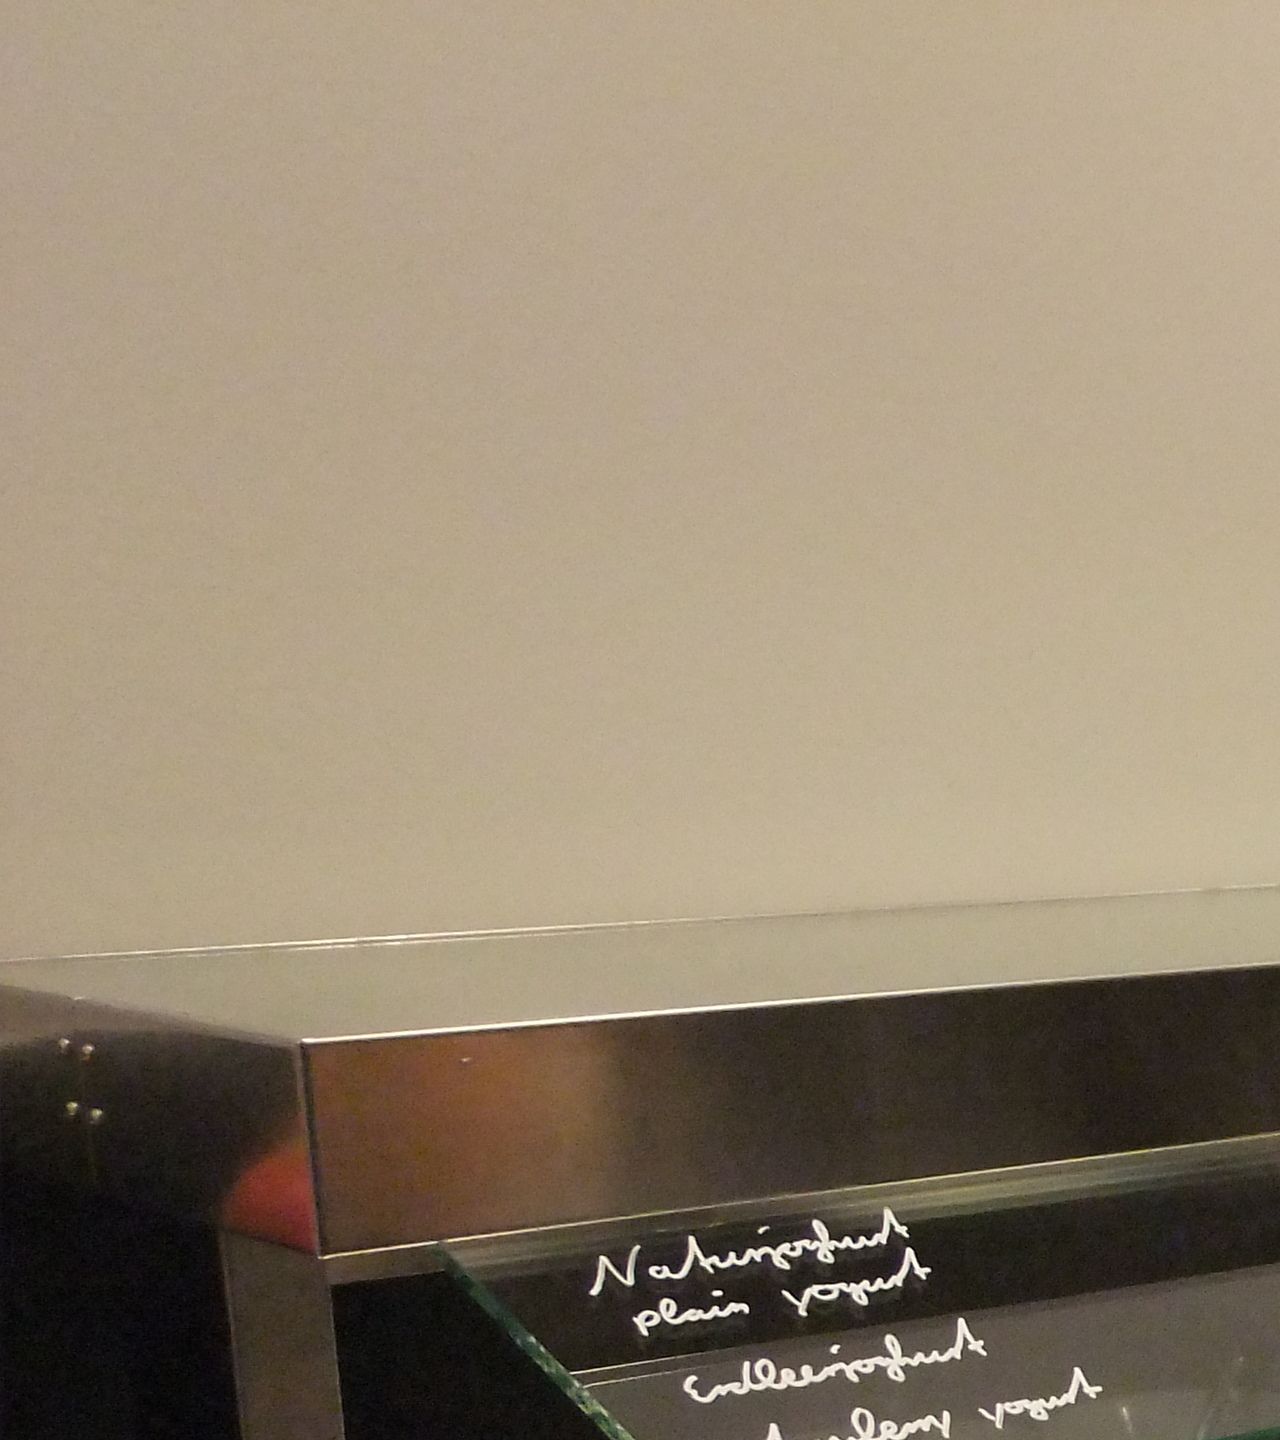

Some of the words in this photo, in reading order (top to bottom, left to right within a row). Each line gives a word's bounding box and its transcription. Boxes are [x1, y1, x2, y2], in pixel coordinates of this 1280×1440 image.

[632, 1290, 751, 1337] plain
[781, 1247, 932, 1317] yogurt
[978, 1366, 1103, 1429] yogurt
